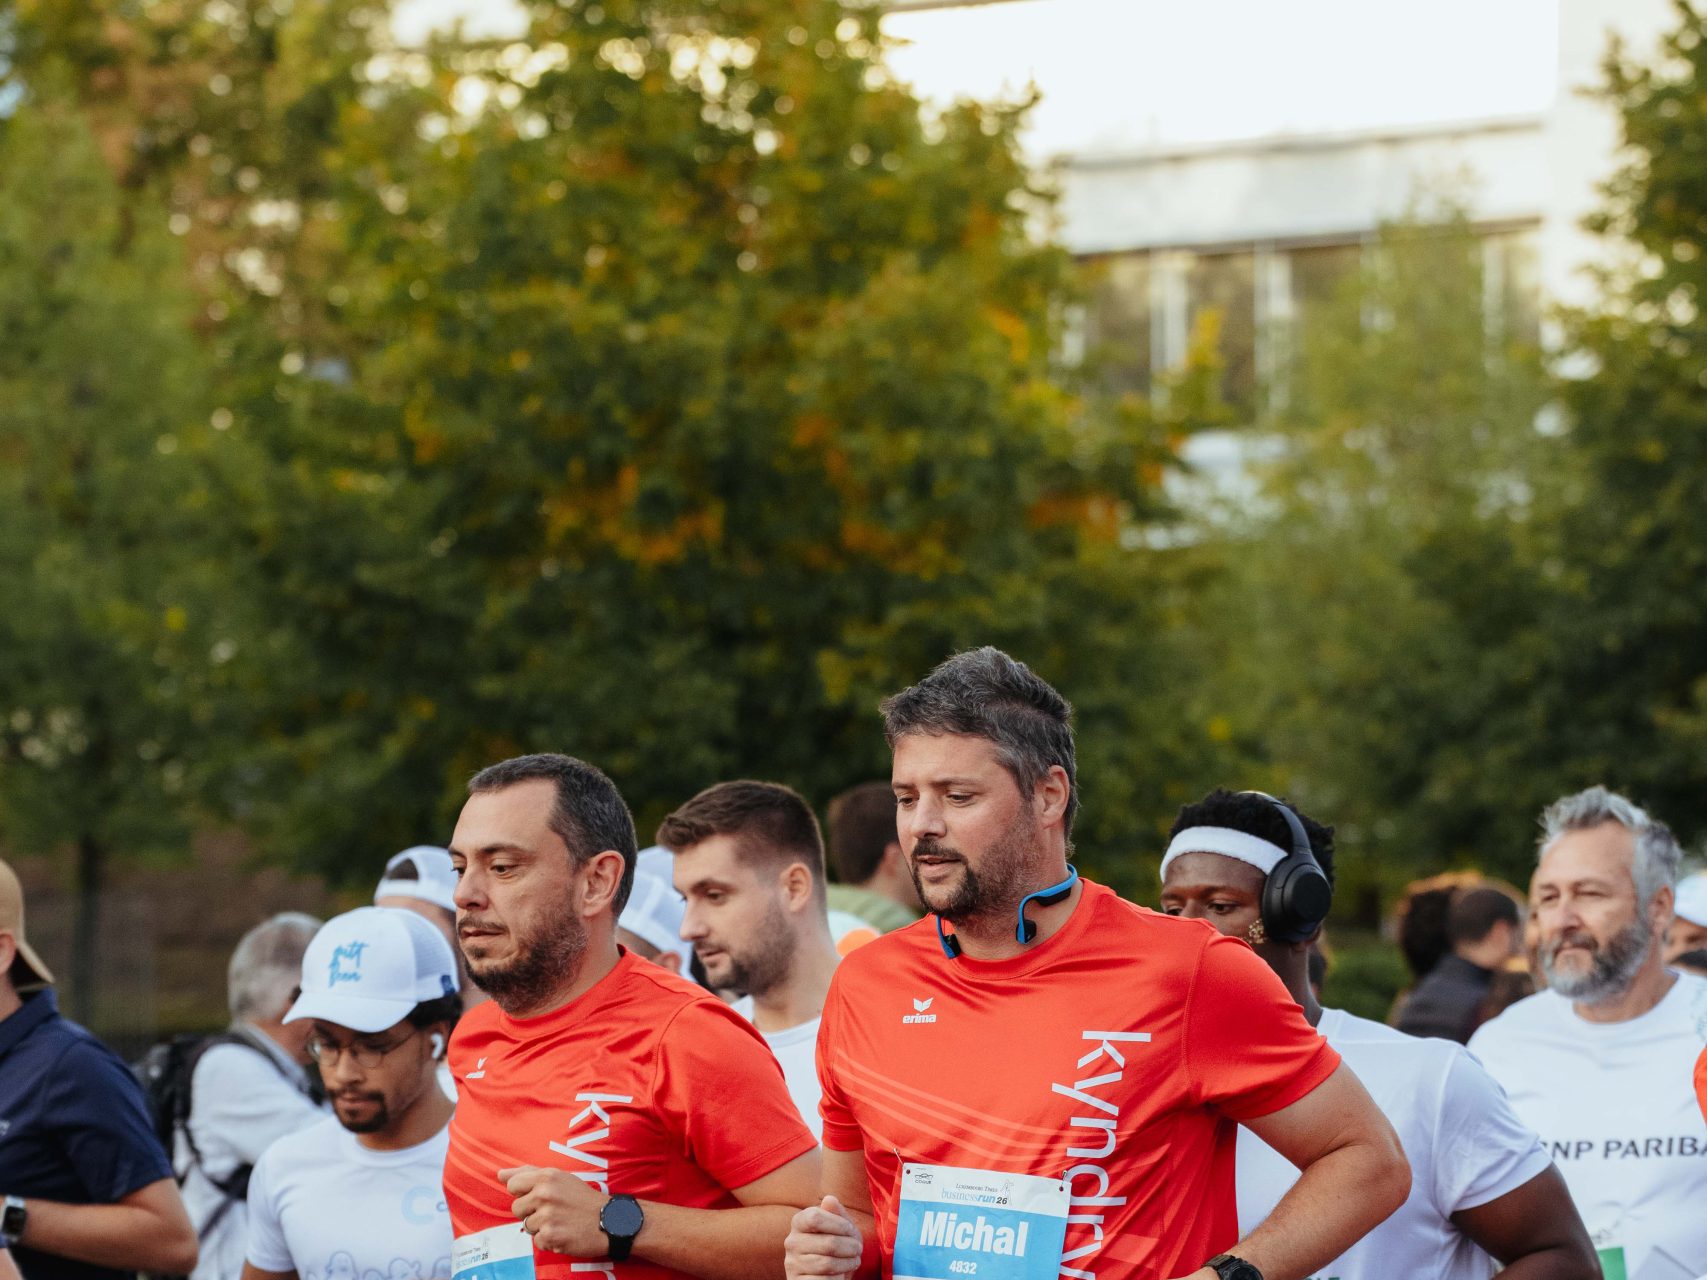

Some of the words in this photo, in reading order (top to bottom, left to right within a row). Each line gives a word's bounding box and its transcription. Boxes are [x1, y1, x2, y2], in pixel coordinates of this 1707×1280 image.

[903, 1013, 937, 1024] erima
[1541, 1141, 1594, 1160] NP
[995, 1196, 1008, 1205] 26
[919, 1211, 1029, 1257] Michal
[949, 1260, 977, 1275] 4832
